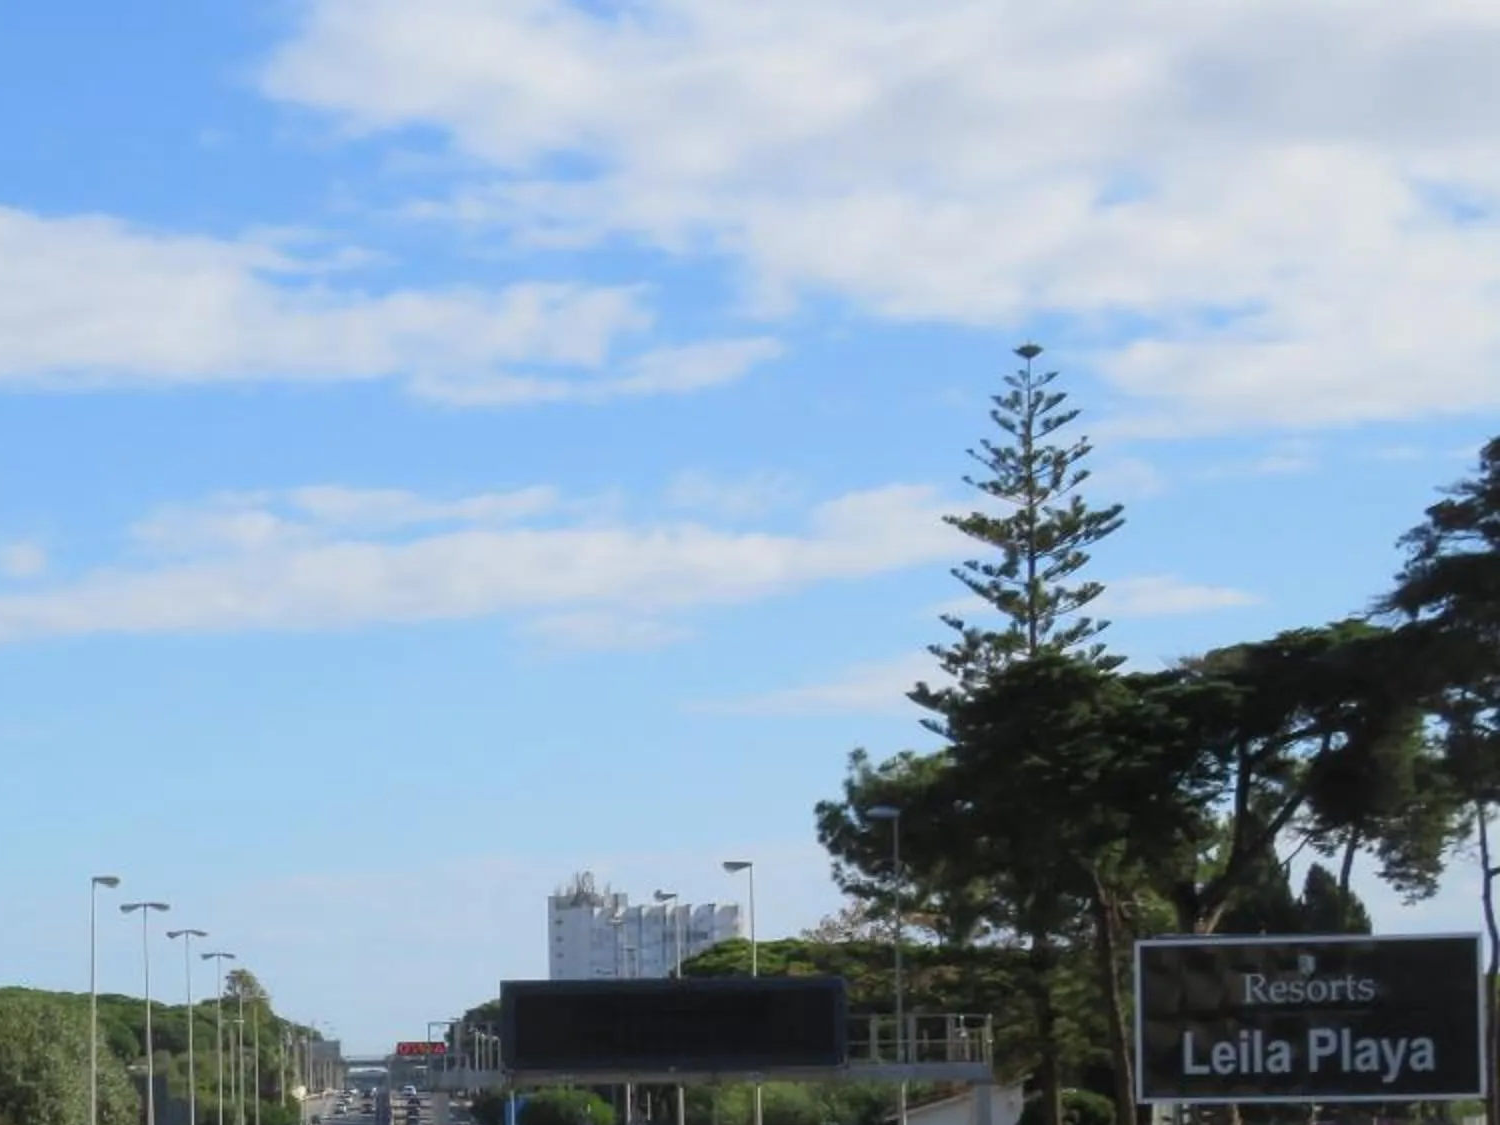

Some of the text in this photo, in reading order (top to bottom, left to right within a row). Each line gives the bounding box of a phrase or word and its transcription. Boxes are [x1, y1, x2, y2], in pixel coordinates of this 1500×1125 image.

[1244, 973, 1376, 1003] Resorts
[1182, 1028, 1436, 1083] Leila Playa
